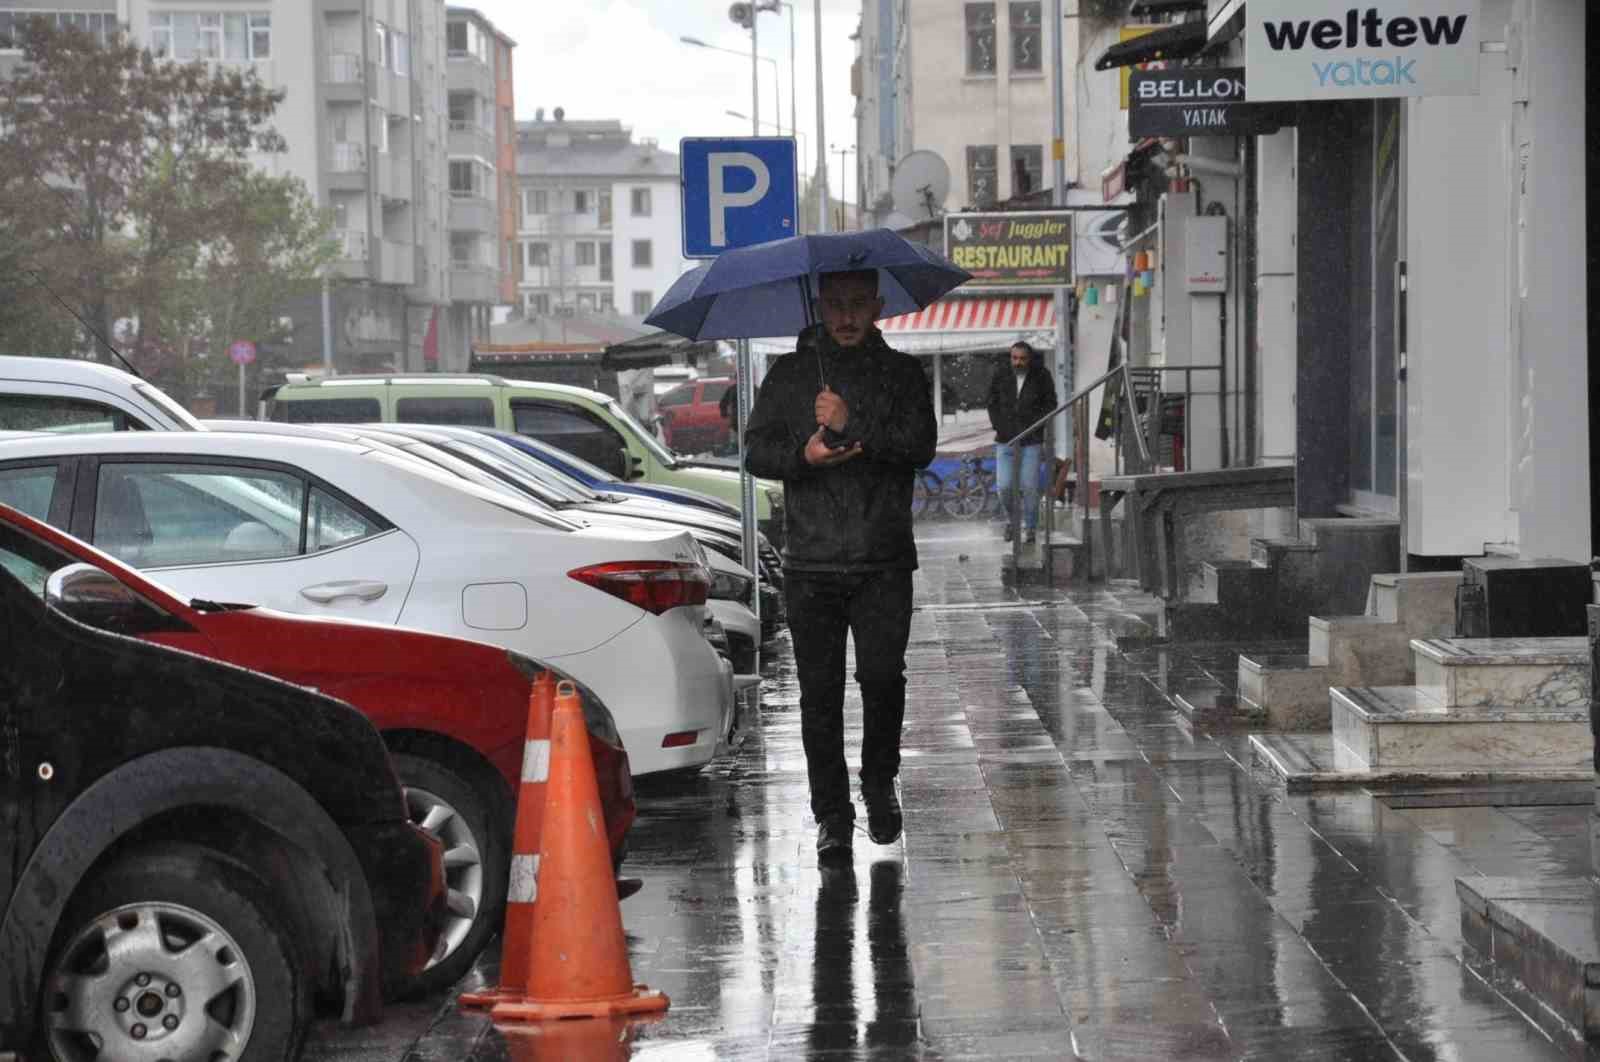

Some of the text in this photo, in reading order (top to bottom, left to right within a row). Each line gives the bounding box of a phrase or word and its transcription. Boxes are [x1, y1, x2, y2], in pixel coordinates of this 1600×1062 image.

[1264, 8, 1468, 51] weltew
[1312, 56, 1416, 87] yatak
[1183, 109, 1227, 127] YATAK
[708, 152, 770, 245] P
[952, 244, 1069, 268] RESTAURANT
